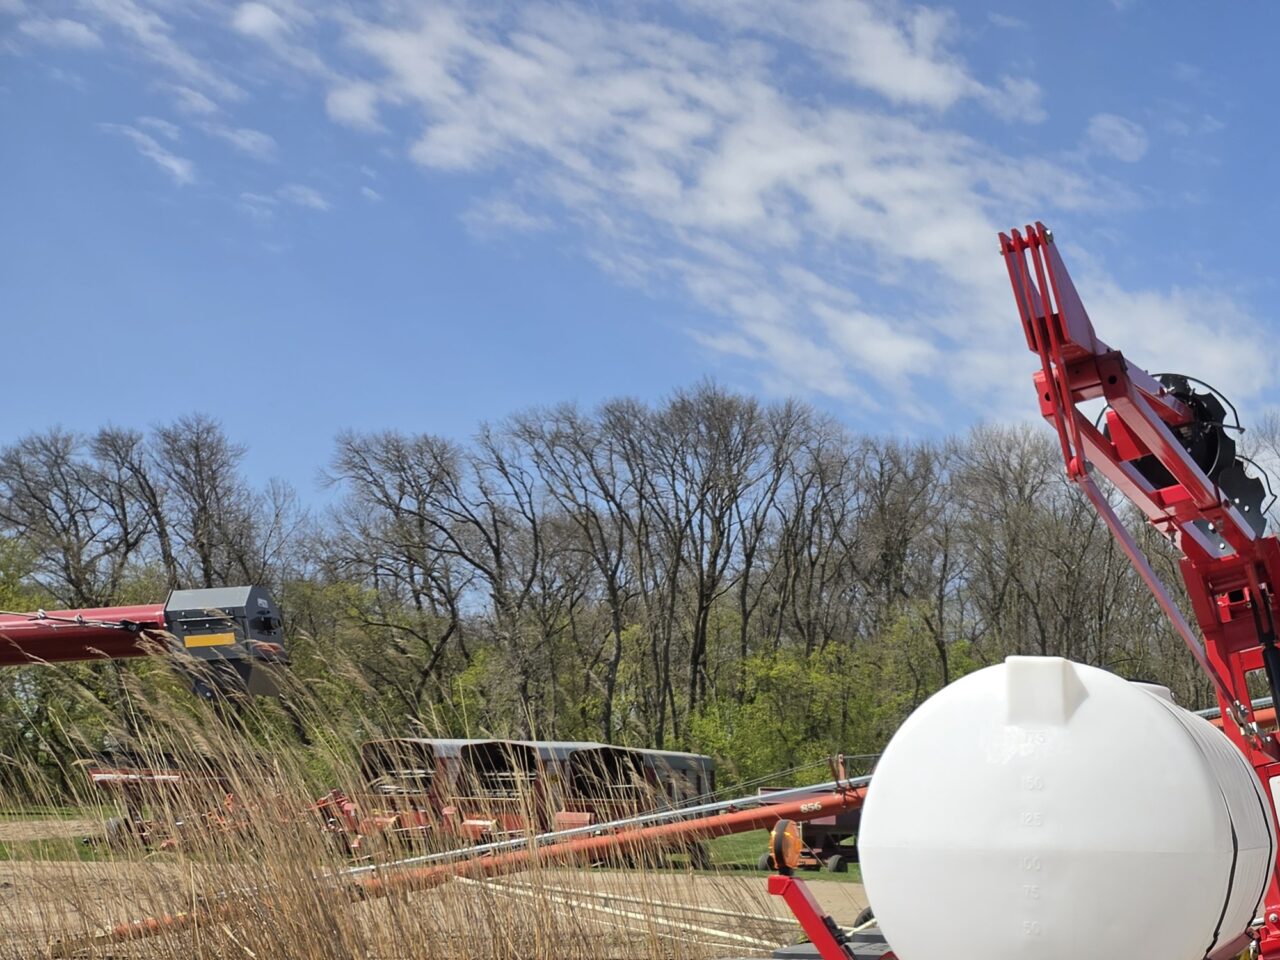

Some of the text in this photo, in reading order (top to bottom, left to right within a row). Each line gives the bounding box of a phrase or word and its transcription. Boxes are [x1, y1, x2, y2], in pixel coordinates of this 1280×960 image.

[800, 802, 822, 813] 856
[1022, 884, 1041, 900] 75
[1022, 920, 1042, 936] 50
